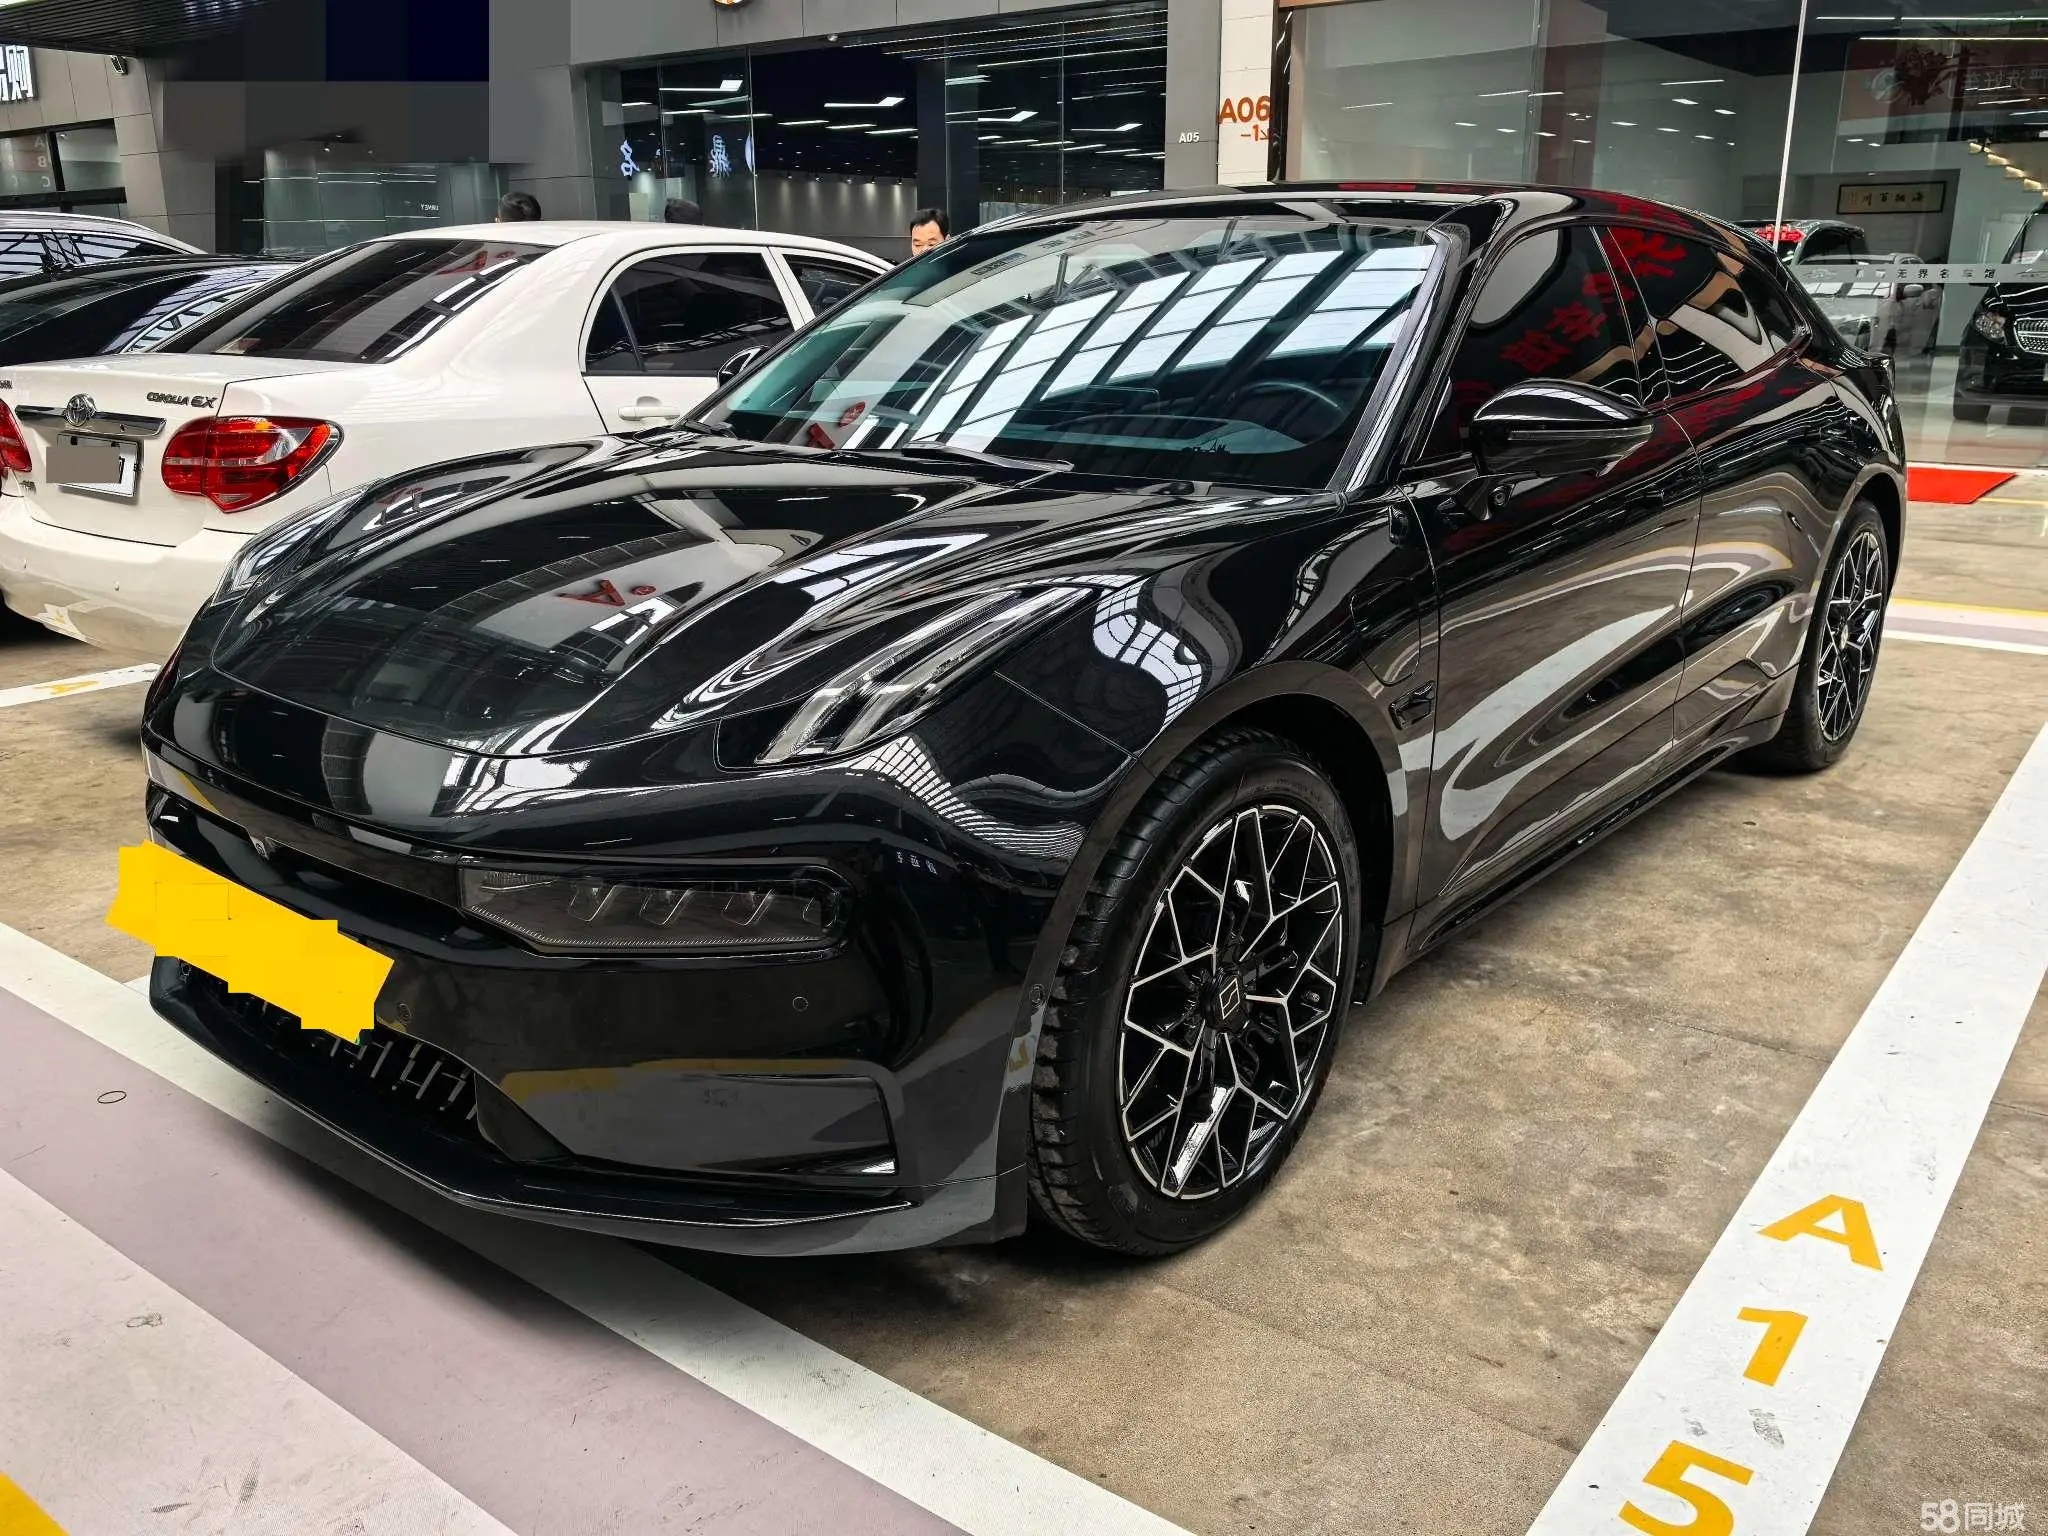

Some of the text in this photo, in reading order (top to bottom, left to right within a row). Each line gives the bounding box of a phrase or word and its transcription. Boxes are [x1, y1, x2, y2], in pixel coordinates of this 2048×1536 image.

[1216, 95, 1271, 124] A06
[1179, 132, 1200, 143] A05
[147, 392, 217, 408] COROLLA EX
